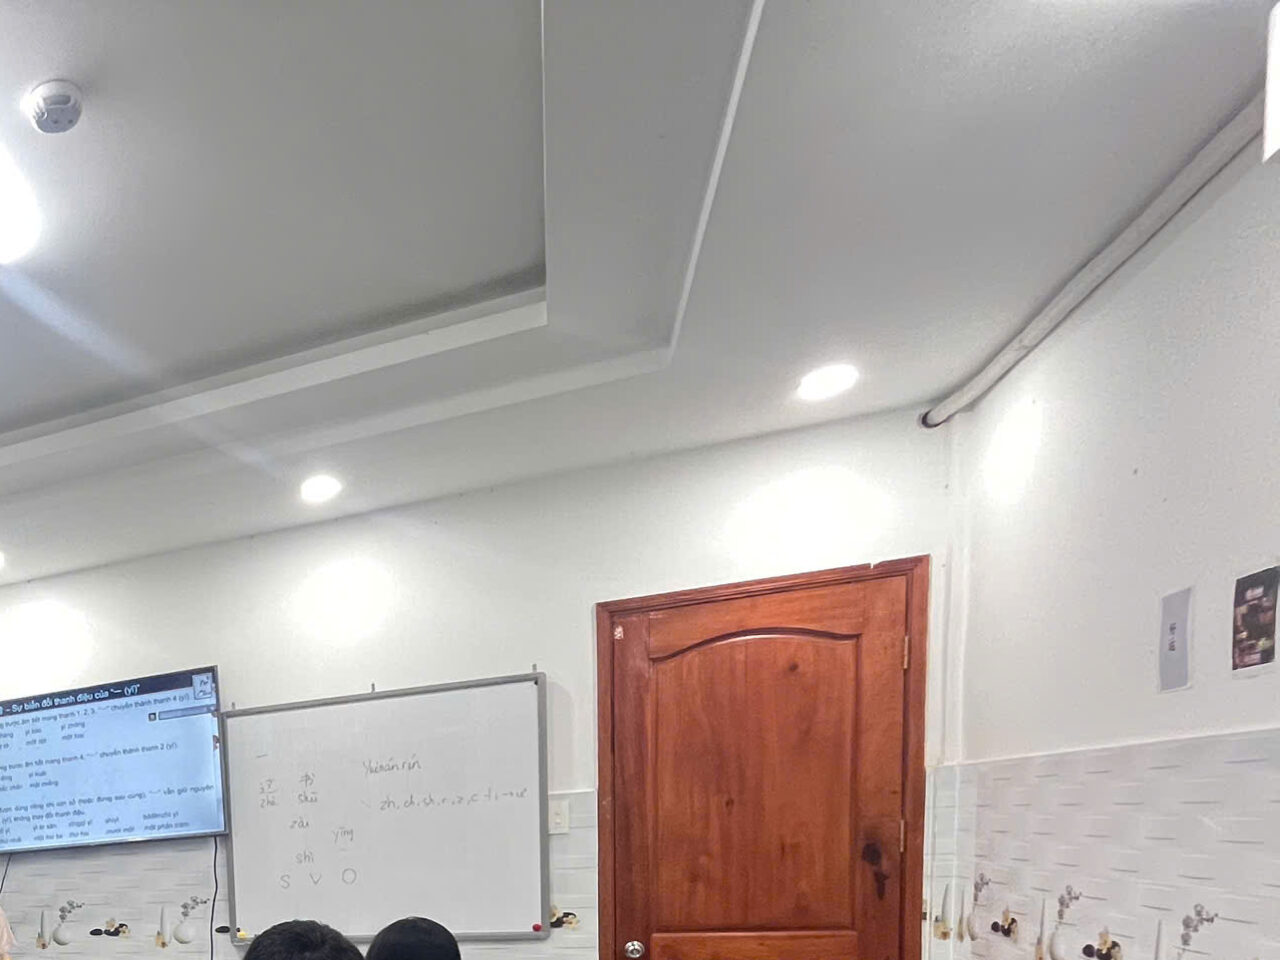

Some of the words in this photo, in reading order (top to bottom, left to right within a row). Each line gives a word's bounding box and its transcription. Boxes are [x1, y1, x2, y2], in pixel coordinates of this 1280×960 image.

[12, 703, 24, 713] Sự
[24, 699, 40, 710] biến
[41, 697, 53, 707] đổi
[54, 695, 75, 706] thanh
[76, 692, 93, 703] điệu
[94, 688, 109, 699] của
[280, 873, 291, 889] S
[308, 872, 322, 885] V
[341, 867, 357, 885] O
